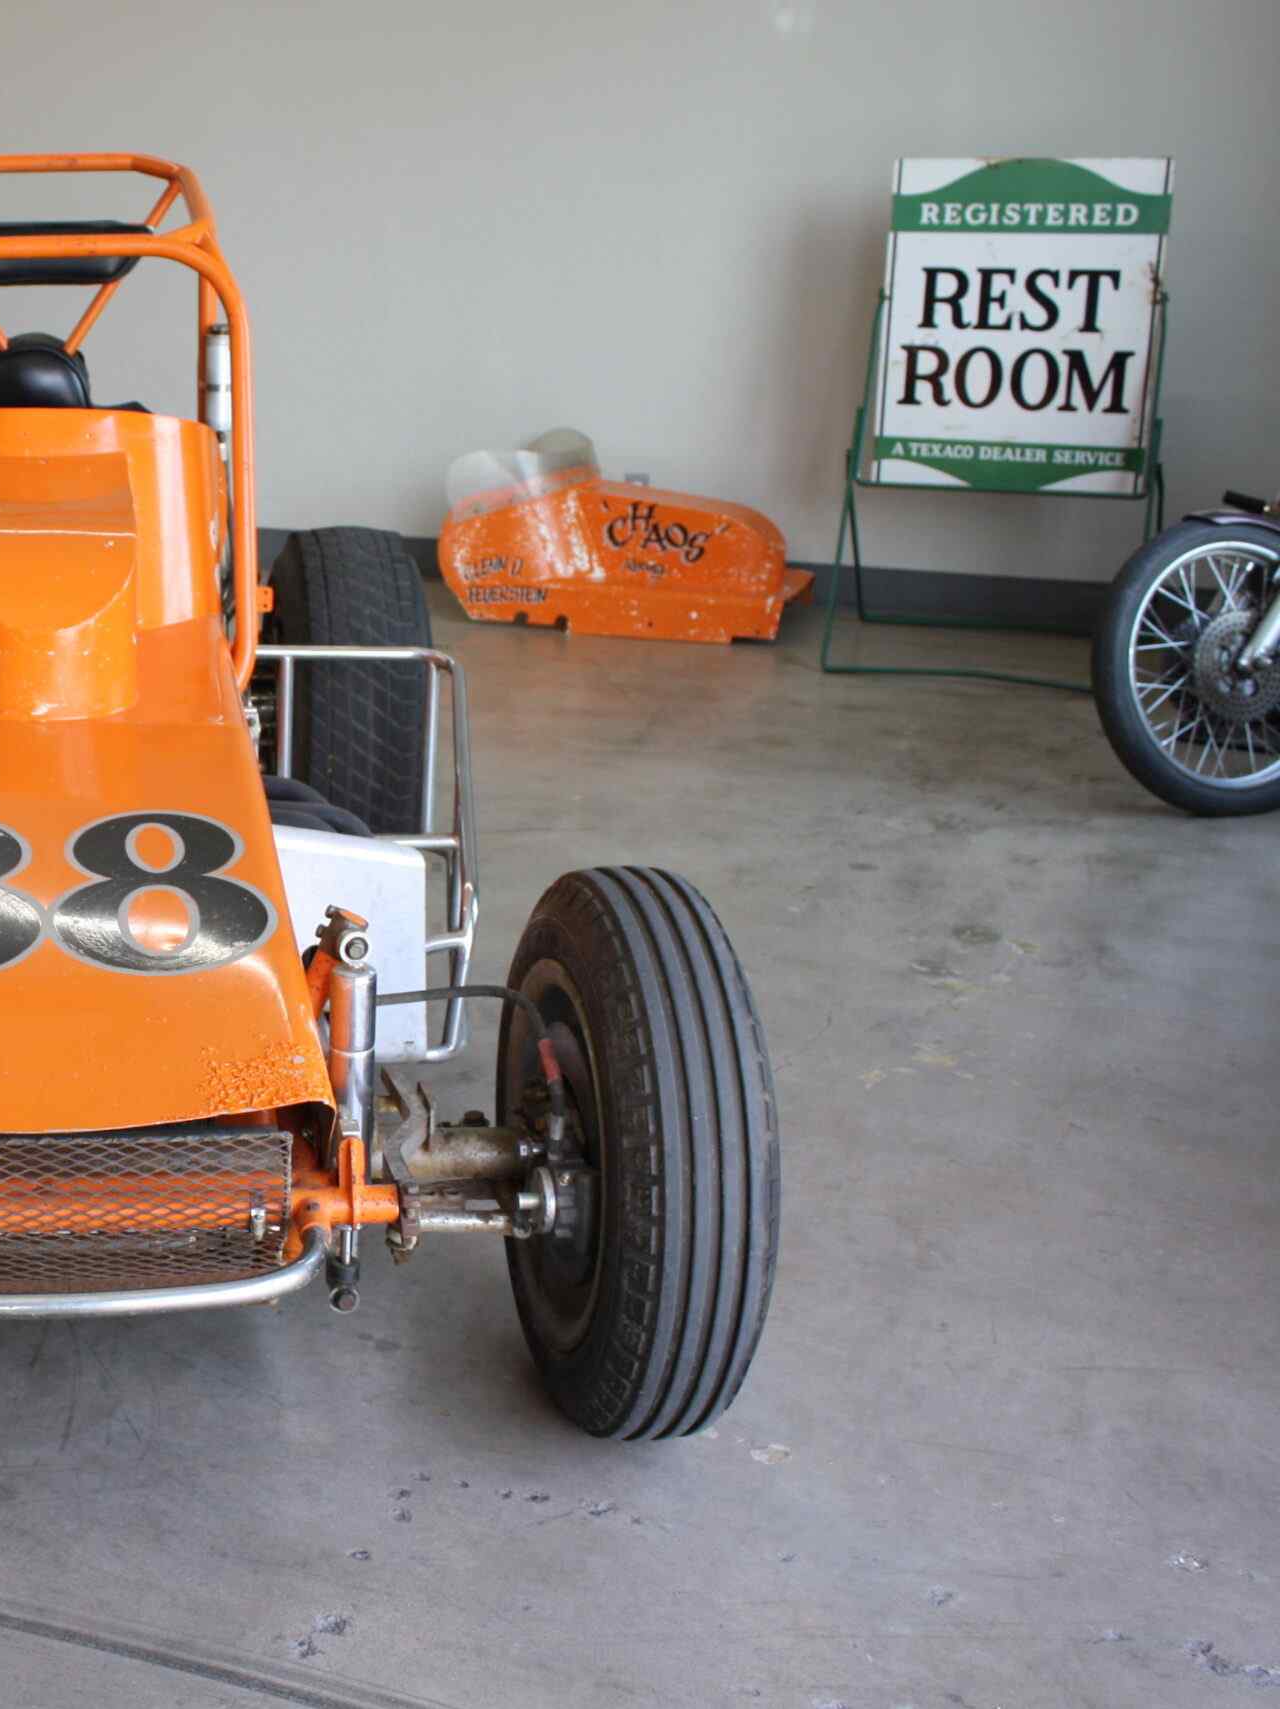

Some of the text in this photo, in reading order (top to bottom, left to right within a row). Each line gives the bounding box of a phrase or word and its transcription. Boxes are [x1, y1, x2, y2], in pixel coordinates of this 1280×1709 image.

[920, 203, 1140, 226] REGISTERED
[917, 267, 1121, 333] REST
[896, 345, 1135, 414] ROOM
[891, 442, 1126, 467] A TEXACO DEALER SERVICE
[607, 502, 712, 562] CHAOS
